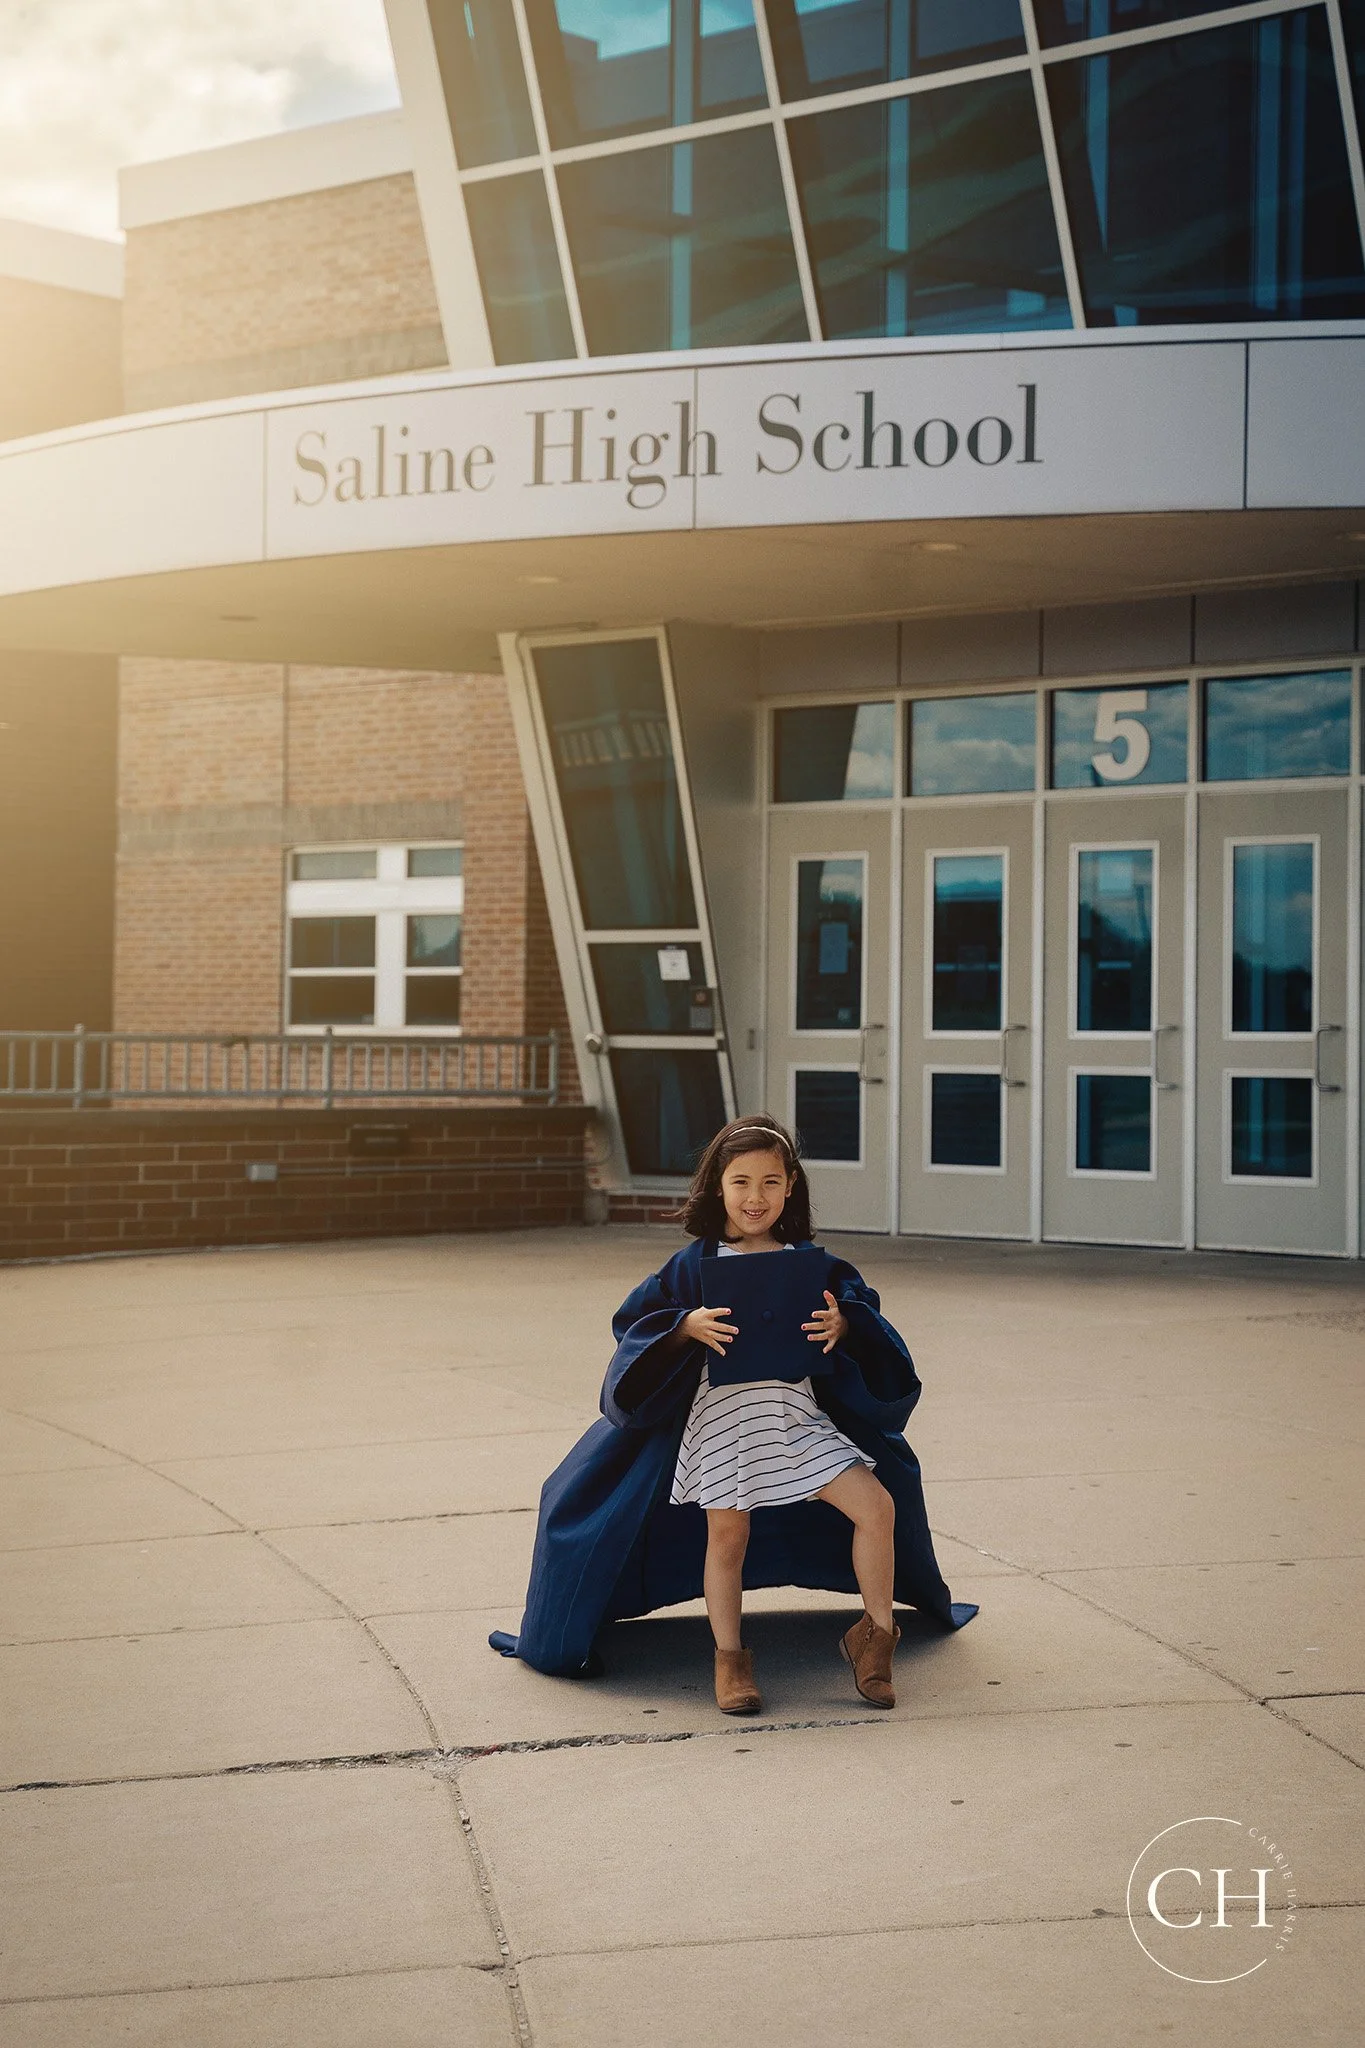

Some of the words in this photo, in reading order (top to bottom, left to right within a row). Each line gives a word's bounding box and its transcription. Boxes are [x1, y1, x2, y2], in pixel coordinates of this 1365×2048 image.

[293, 424, 496, 507] Saline
[524, 400, 722, 509] High
[756, 383, 1044, 476] School
[1091, 690, 1151, 781] 5
